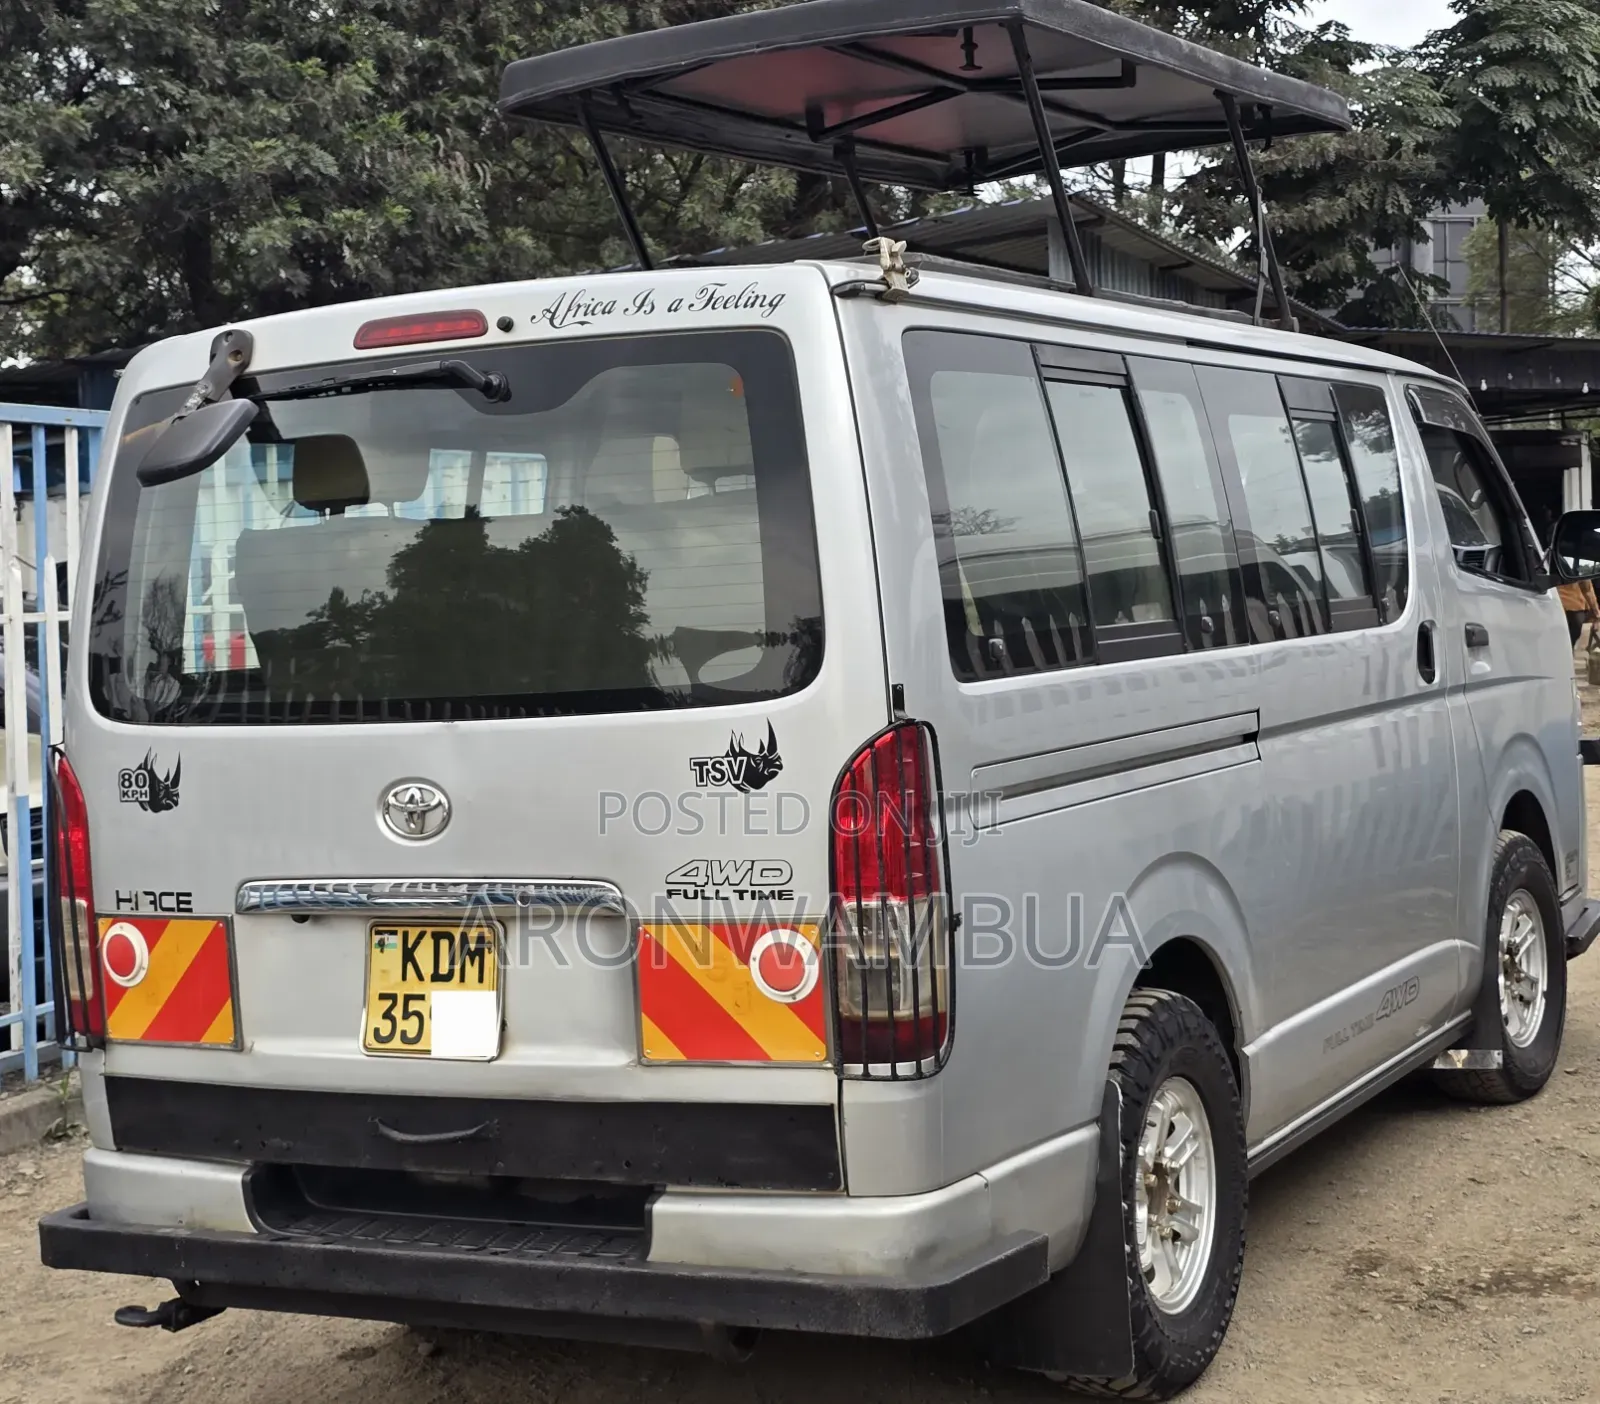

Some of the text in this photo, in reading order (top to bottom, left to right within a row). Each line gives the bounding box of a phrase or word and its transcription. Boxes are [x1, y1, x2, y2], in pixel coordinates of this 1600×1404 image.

[530, 288, 617, 329] Africa
[667, 297, 684, 313] a
[688, 281, 786, 318] Feeling
[120, 772, 148, 789] 80
[690, 757, 748, 787] TSV
[122, 790, 148, 799] KPH
[665, 859, 793, 887] 4WD
[666, 888, 795, 901] FULL TIME
[401, 930, 486, 984] KDM
[373, 992, 433, 1046] 35
